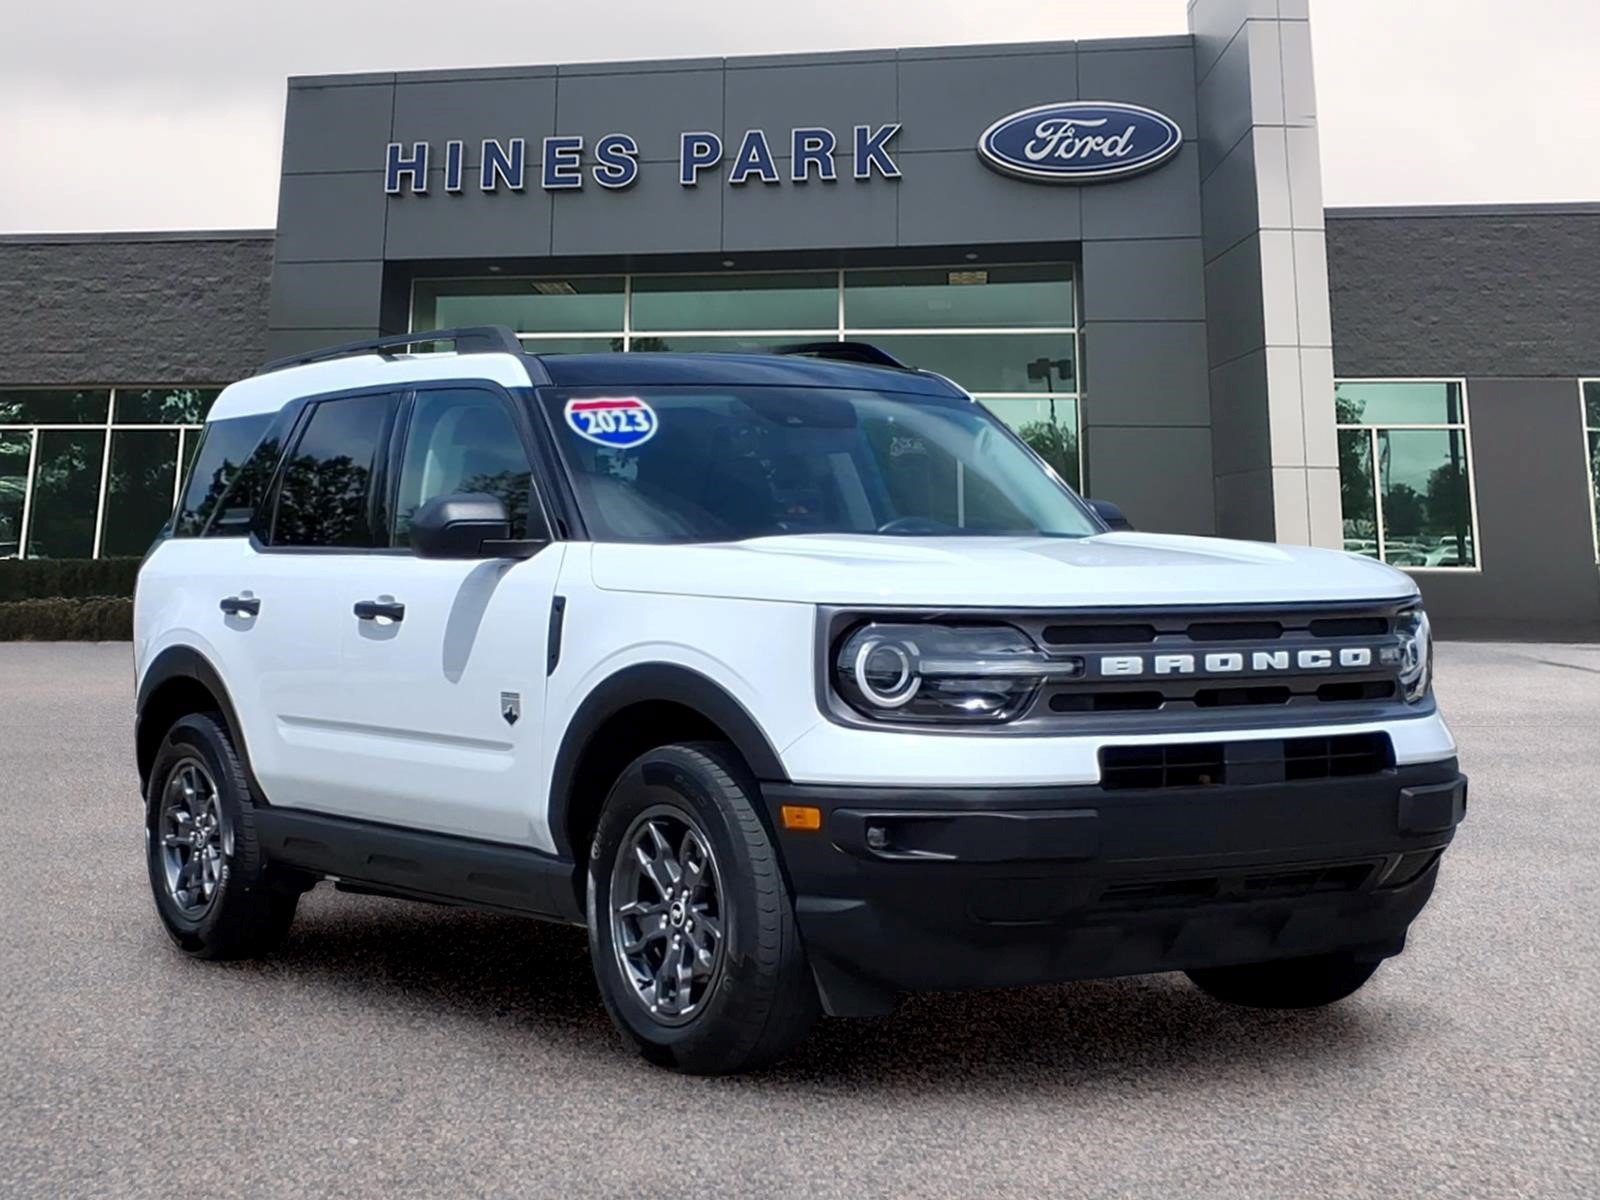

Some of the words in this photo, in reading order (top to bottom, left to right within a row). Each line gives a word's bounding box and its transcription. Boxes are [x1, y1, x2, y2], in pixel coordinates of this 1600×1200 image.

[1024, 118, 1136, 160] Ford
[384, 133, 639, 193] HINES
[680, 123, 902, 185] PARK
[580, 410, 650, 433] 2023
[1100, 648, 1371, 675] BRONCO
